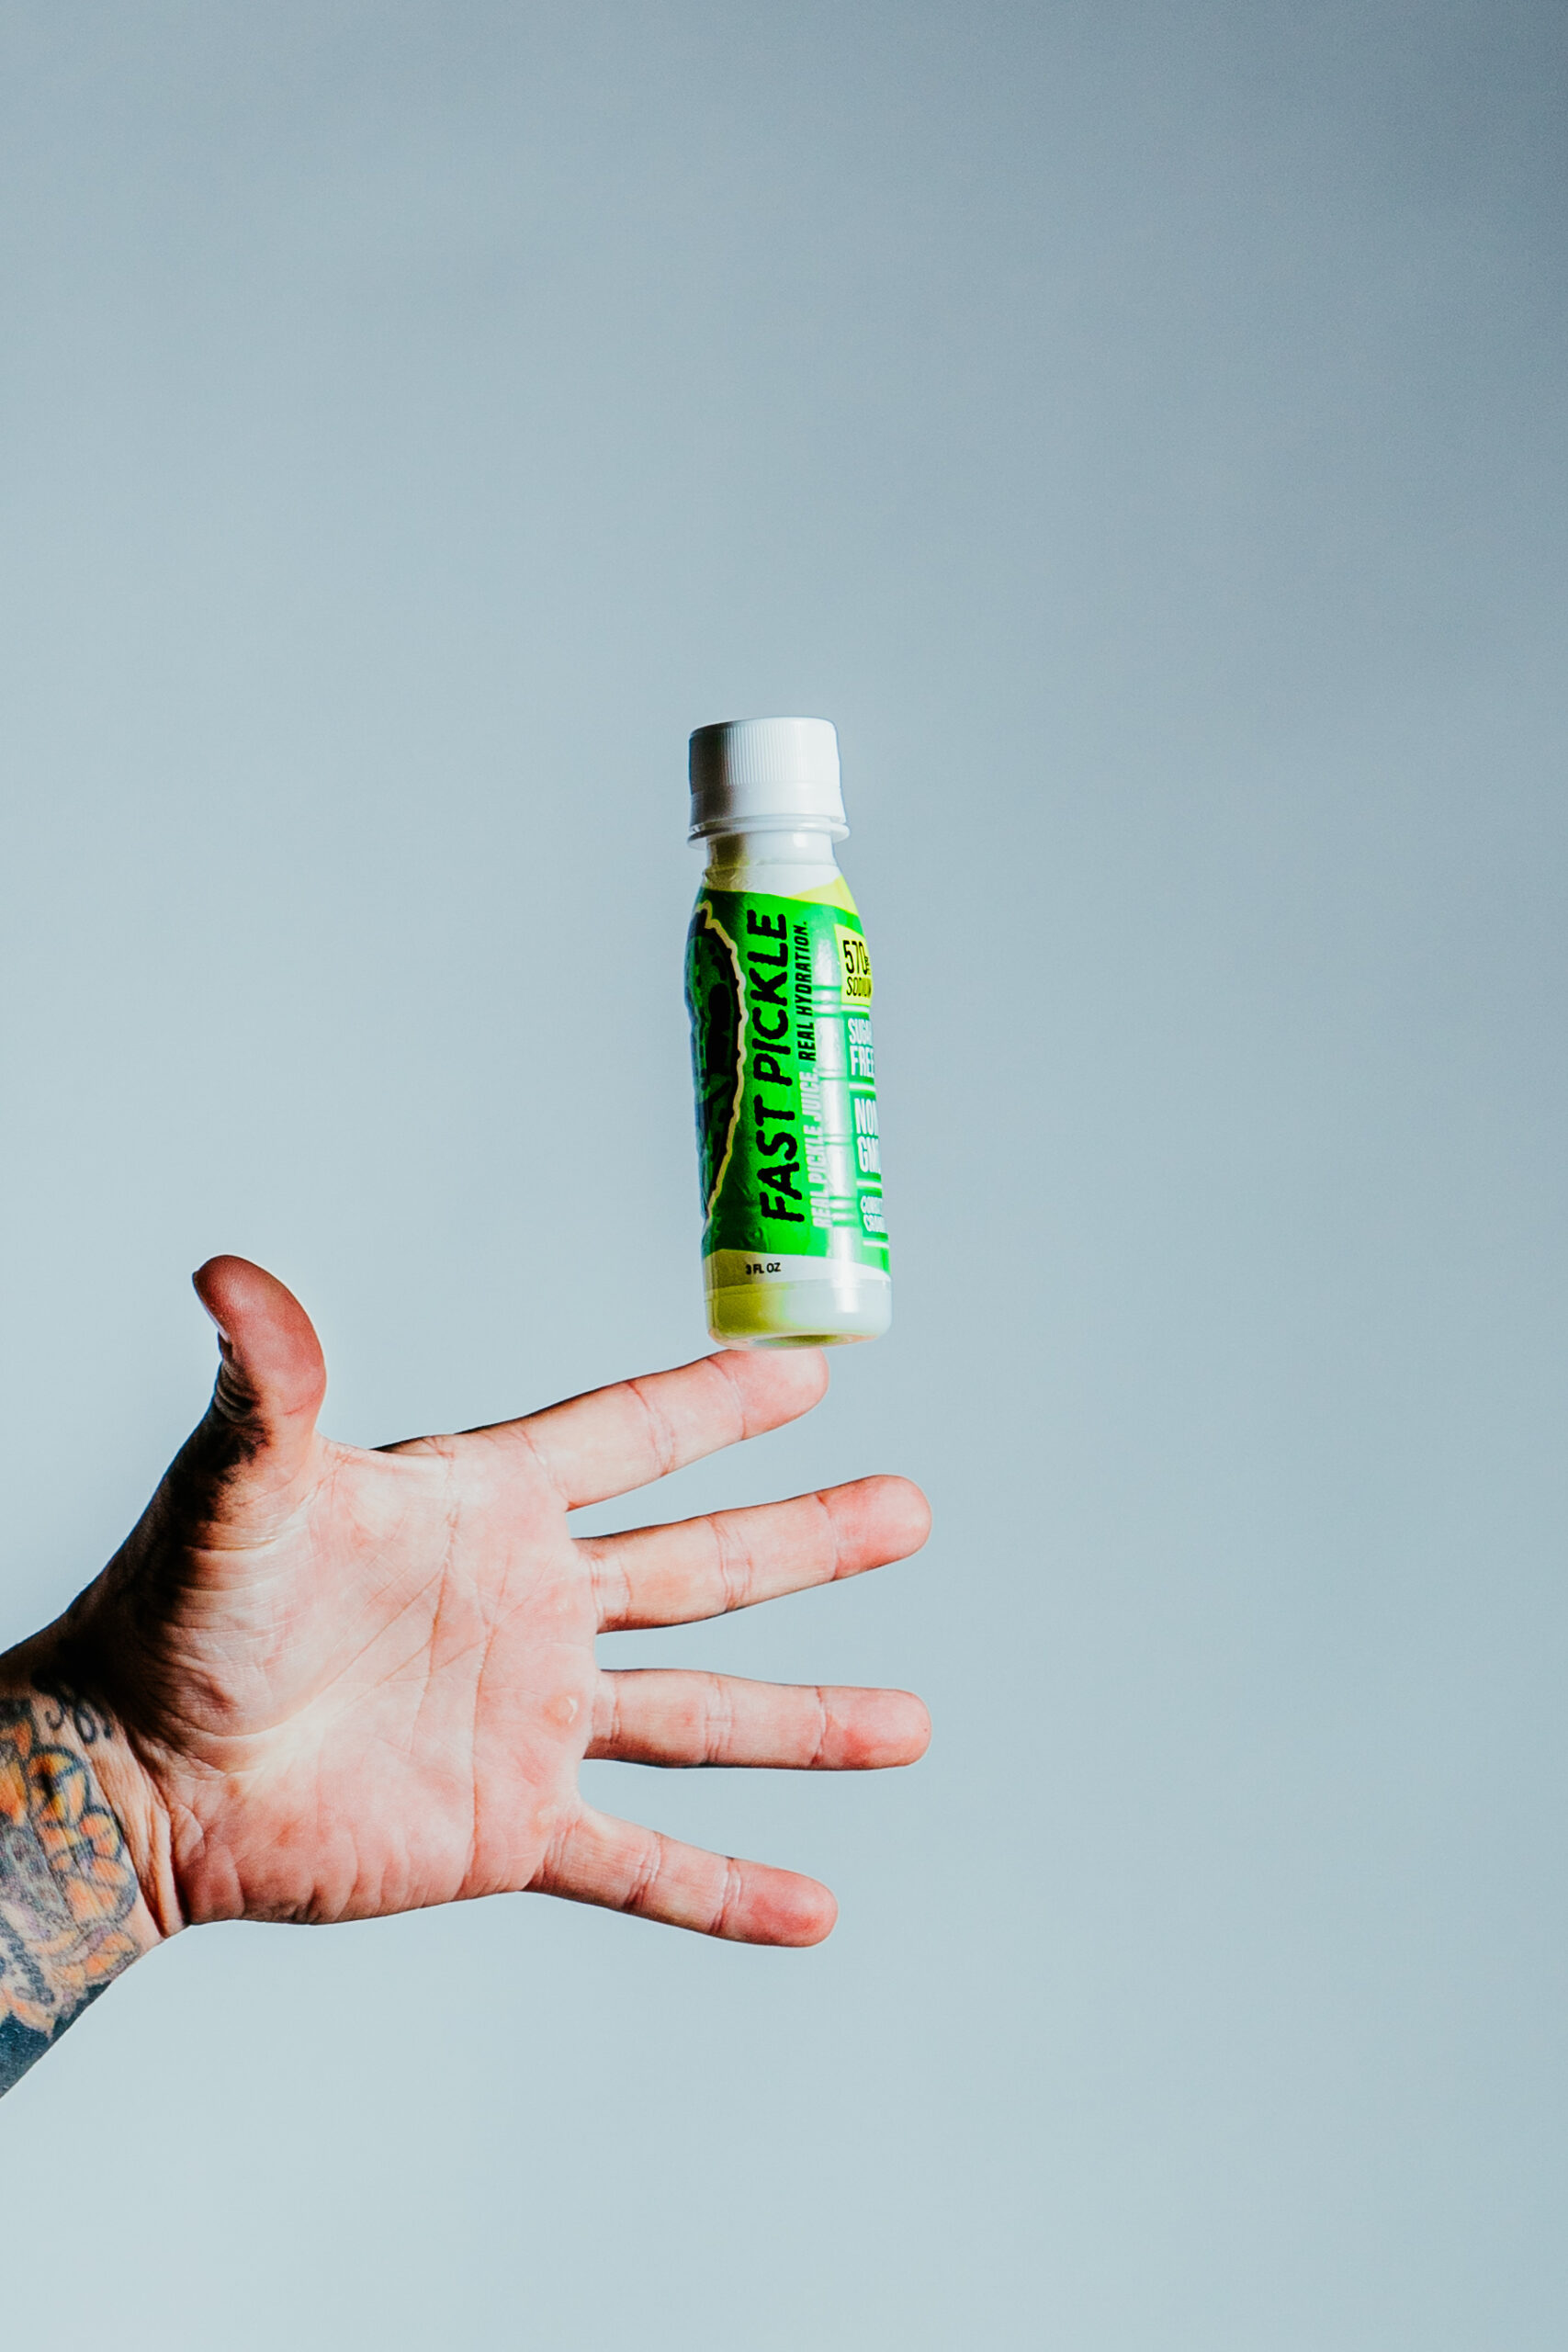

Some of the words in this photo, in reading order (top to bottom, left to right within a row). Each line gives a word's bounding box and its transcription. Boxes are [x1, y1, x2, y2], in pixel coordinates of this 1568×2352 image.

[794, 921, 814, 1017] HYDRATION.
[842, 939, 868, 975] 570
[747, 909, 794, 1087] PICKLE
[796, 1022, 817, 1062] REAL
[753, 1093, 806, 1223] FAST
[803, 1124, 827, 1184] PICKLE
[808, 1190, 833, 1228] REAL
[746, 1263, 752, 1275] 3
[753, 1263, 764, 1274] FL
[766, 1262, 781, 1273] OZ
